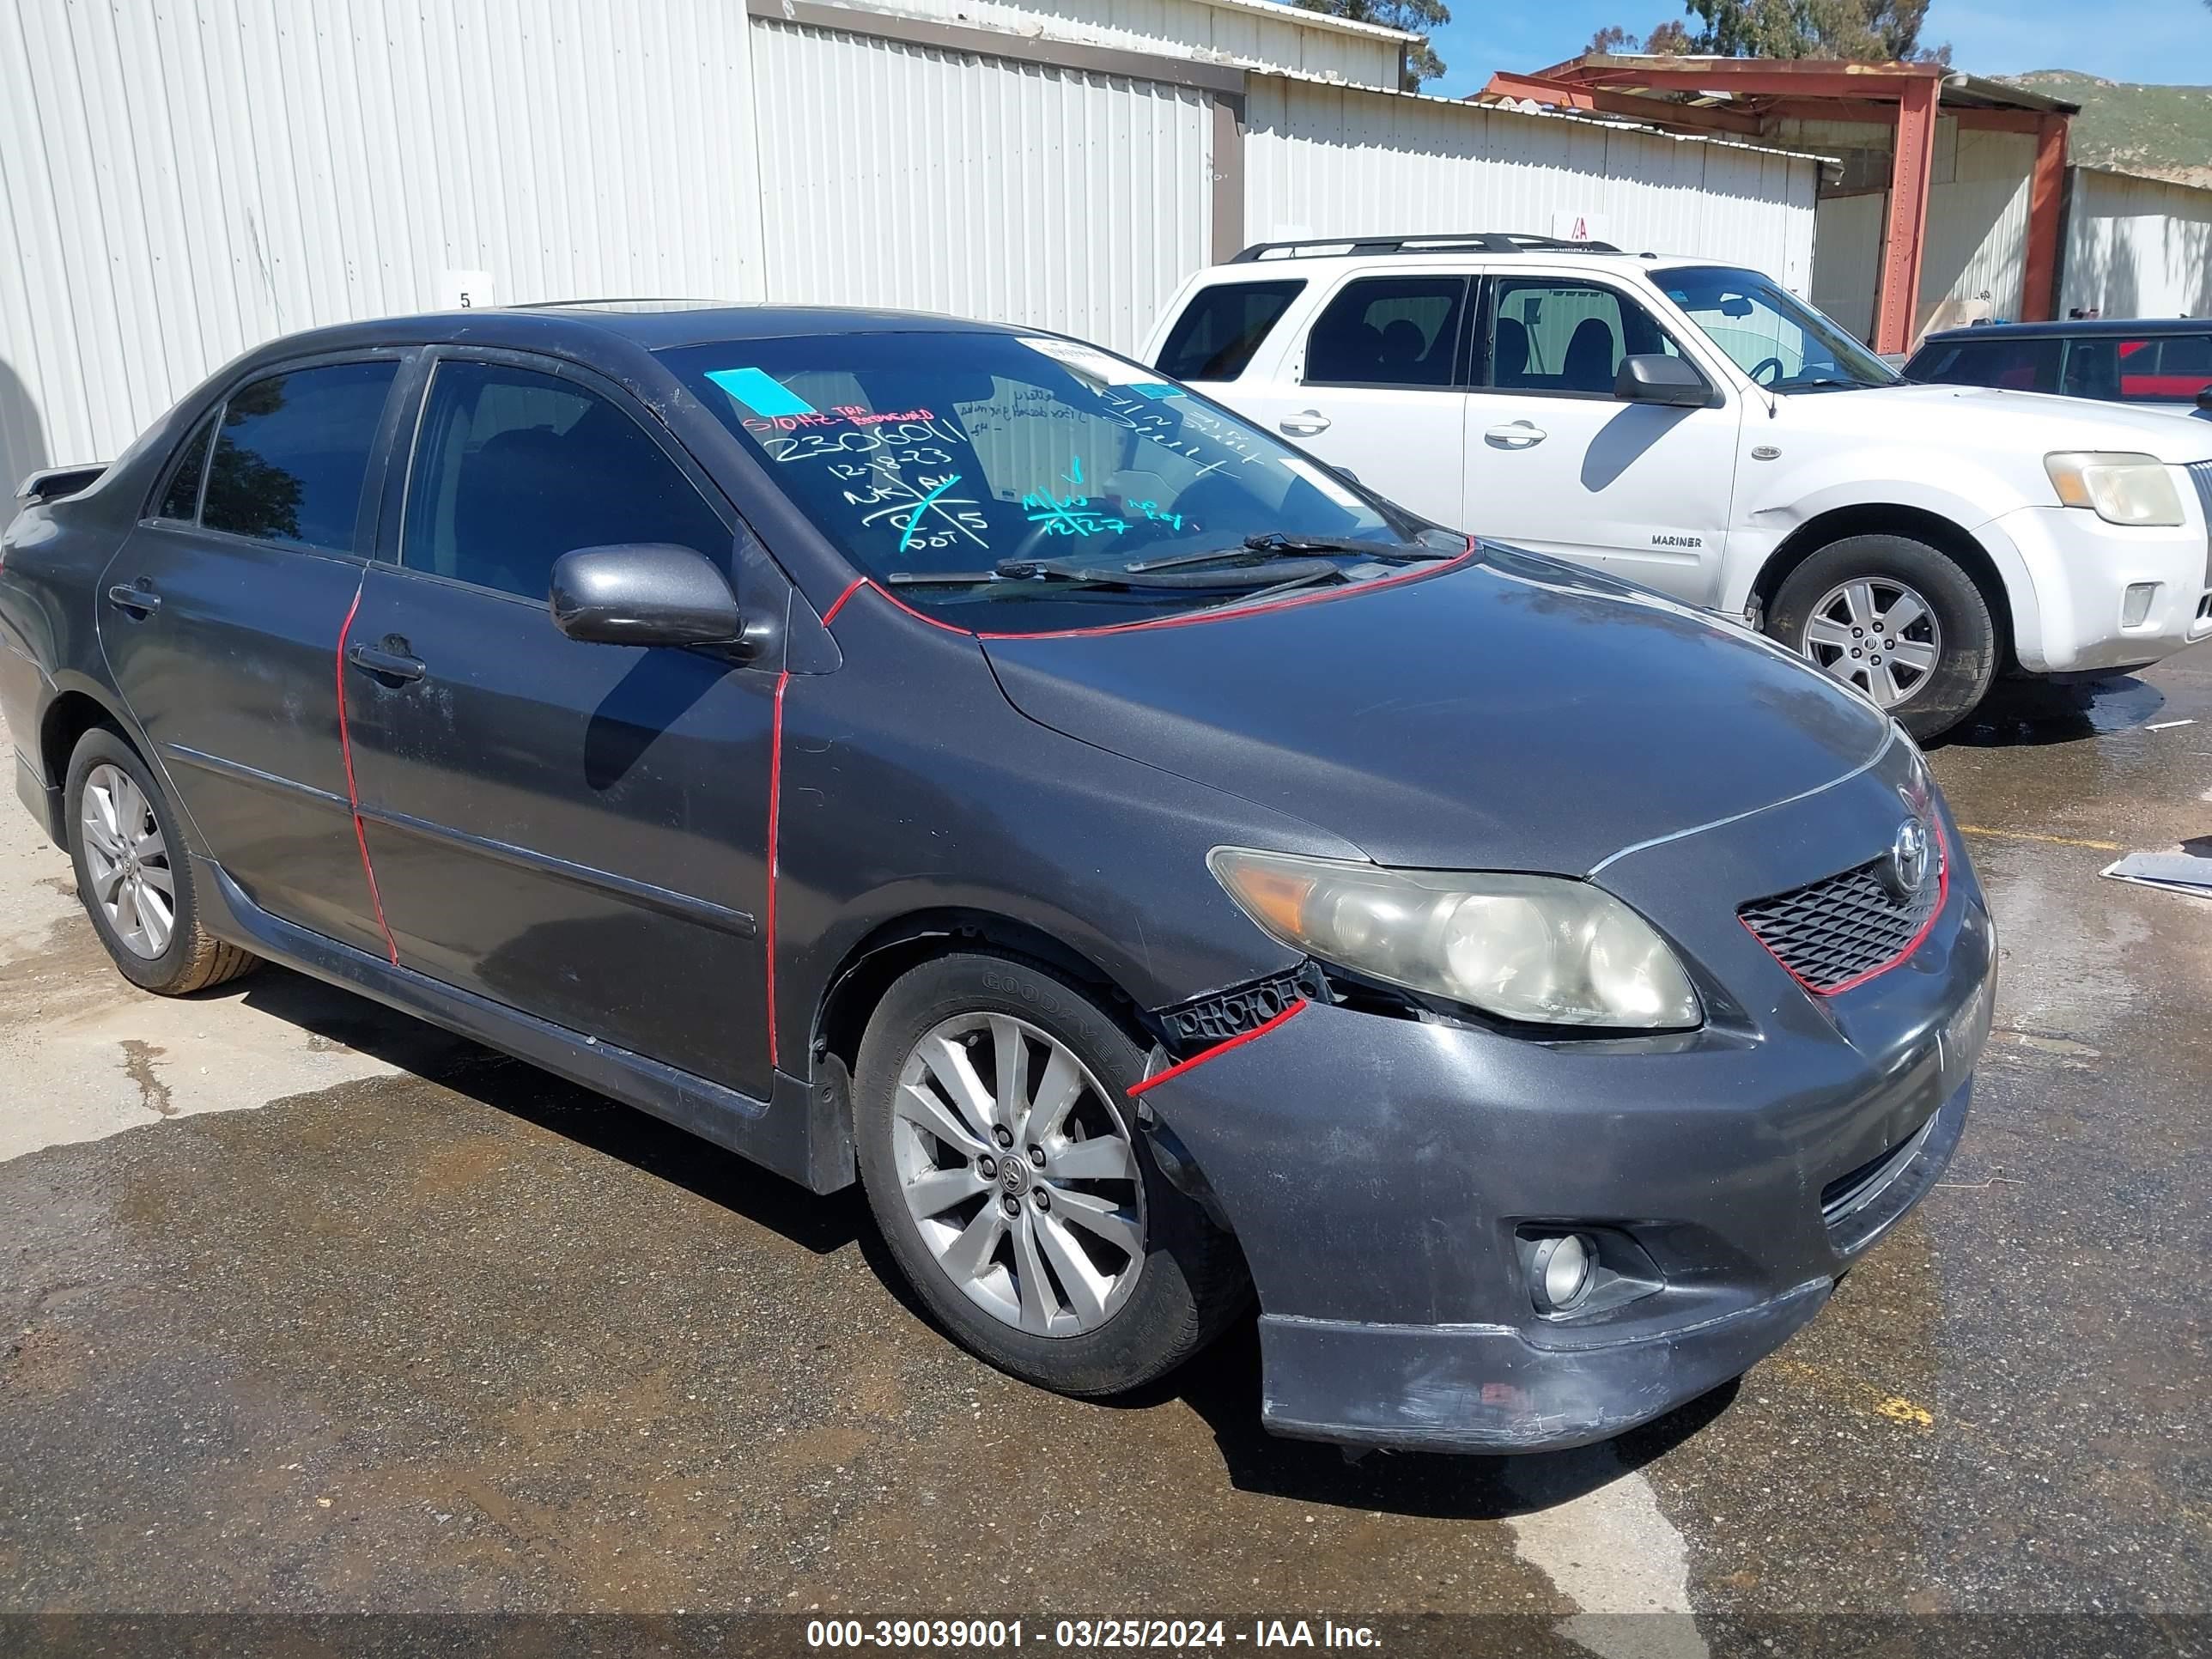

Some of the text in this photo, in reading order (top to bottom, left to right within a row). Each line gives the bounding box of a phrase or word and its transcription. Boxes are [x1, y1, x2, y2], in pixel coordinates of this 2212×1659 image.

[460, 292, 471, 308] 5
[763, 418, 968, 462] 2306011
[828, 447, 952, 480] 12-18-23
[1651, 534, 1702, 548] MARINER
[982, 971, 1129, 1087] GOODYEA
